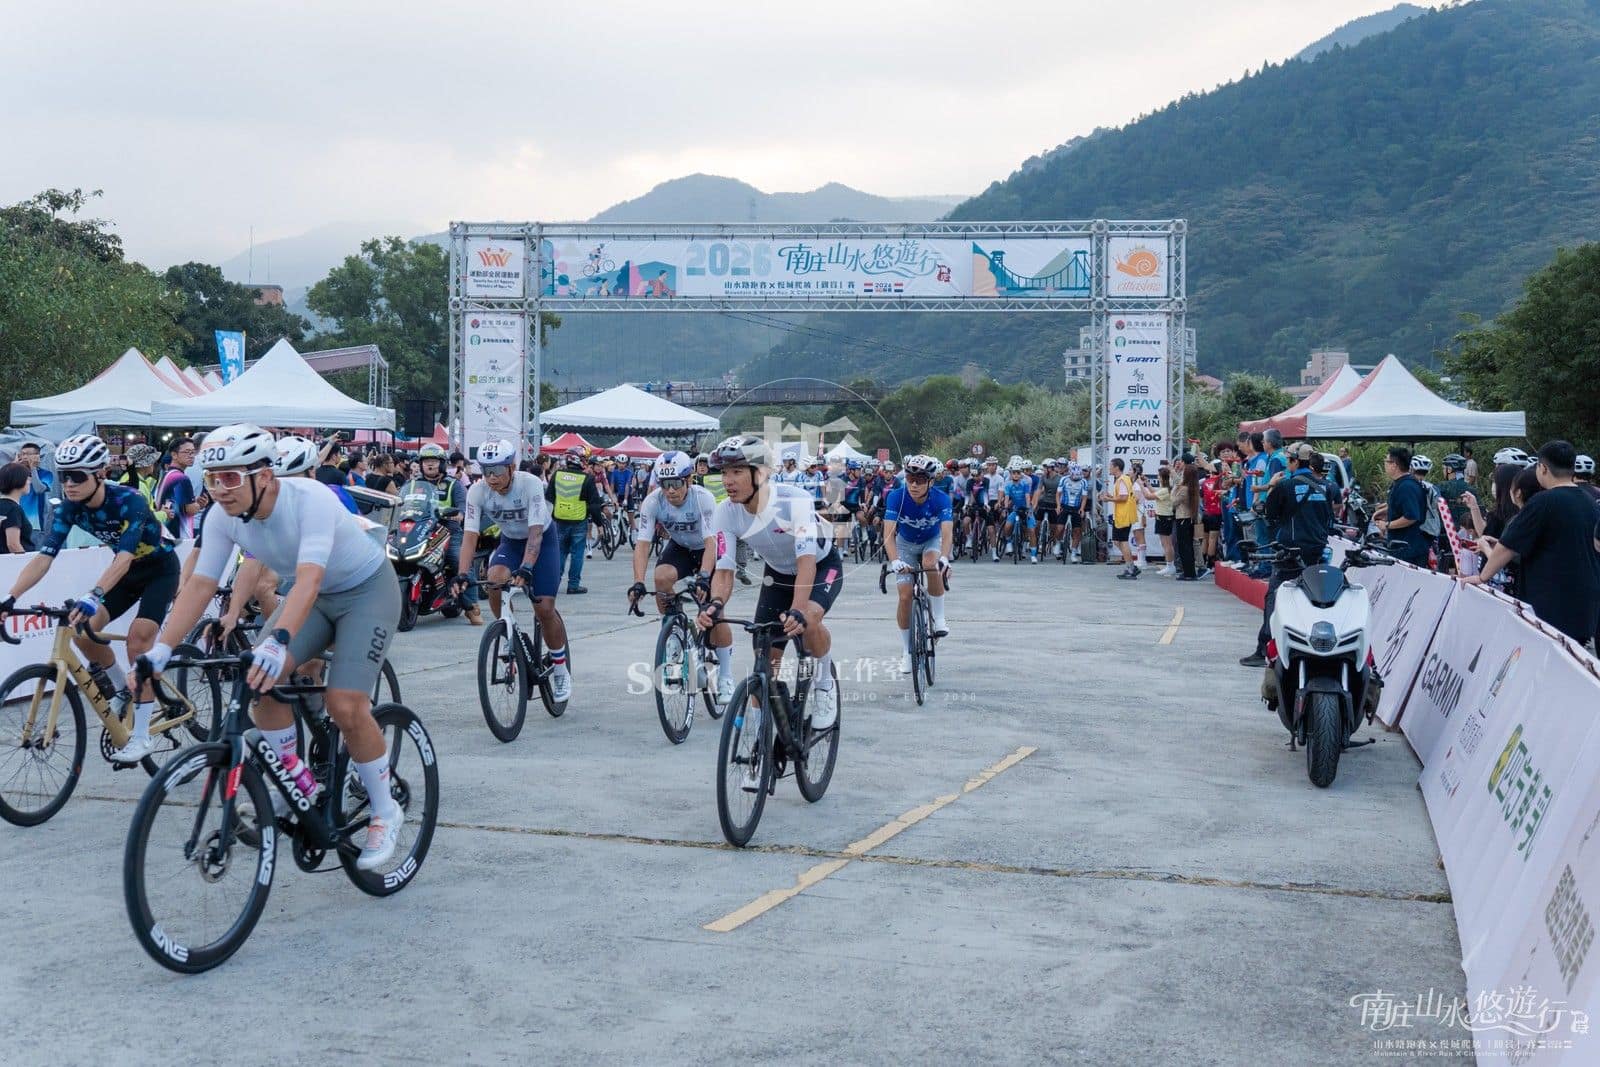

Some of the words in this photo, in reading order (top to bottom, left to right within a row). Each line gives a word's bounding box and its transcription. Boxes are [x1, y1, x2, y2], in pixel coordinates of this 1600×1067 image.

[686, 242, 772, 276] 2026
[778, 240, 946, 279] 南庄山水悠遊行
[1113, 419, 1160, 427] GARMIN
[1114, 429, 1162, 441] wahoo
[1132, 446, 1161, 455] SWISS
[659, 467, 677, 476] 402
[367, 626, 387, 664] RCC
[1421, 652, 1464, 719] GARMIN
[258, 740, 311, 812] COLNAGO
